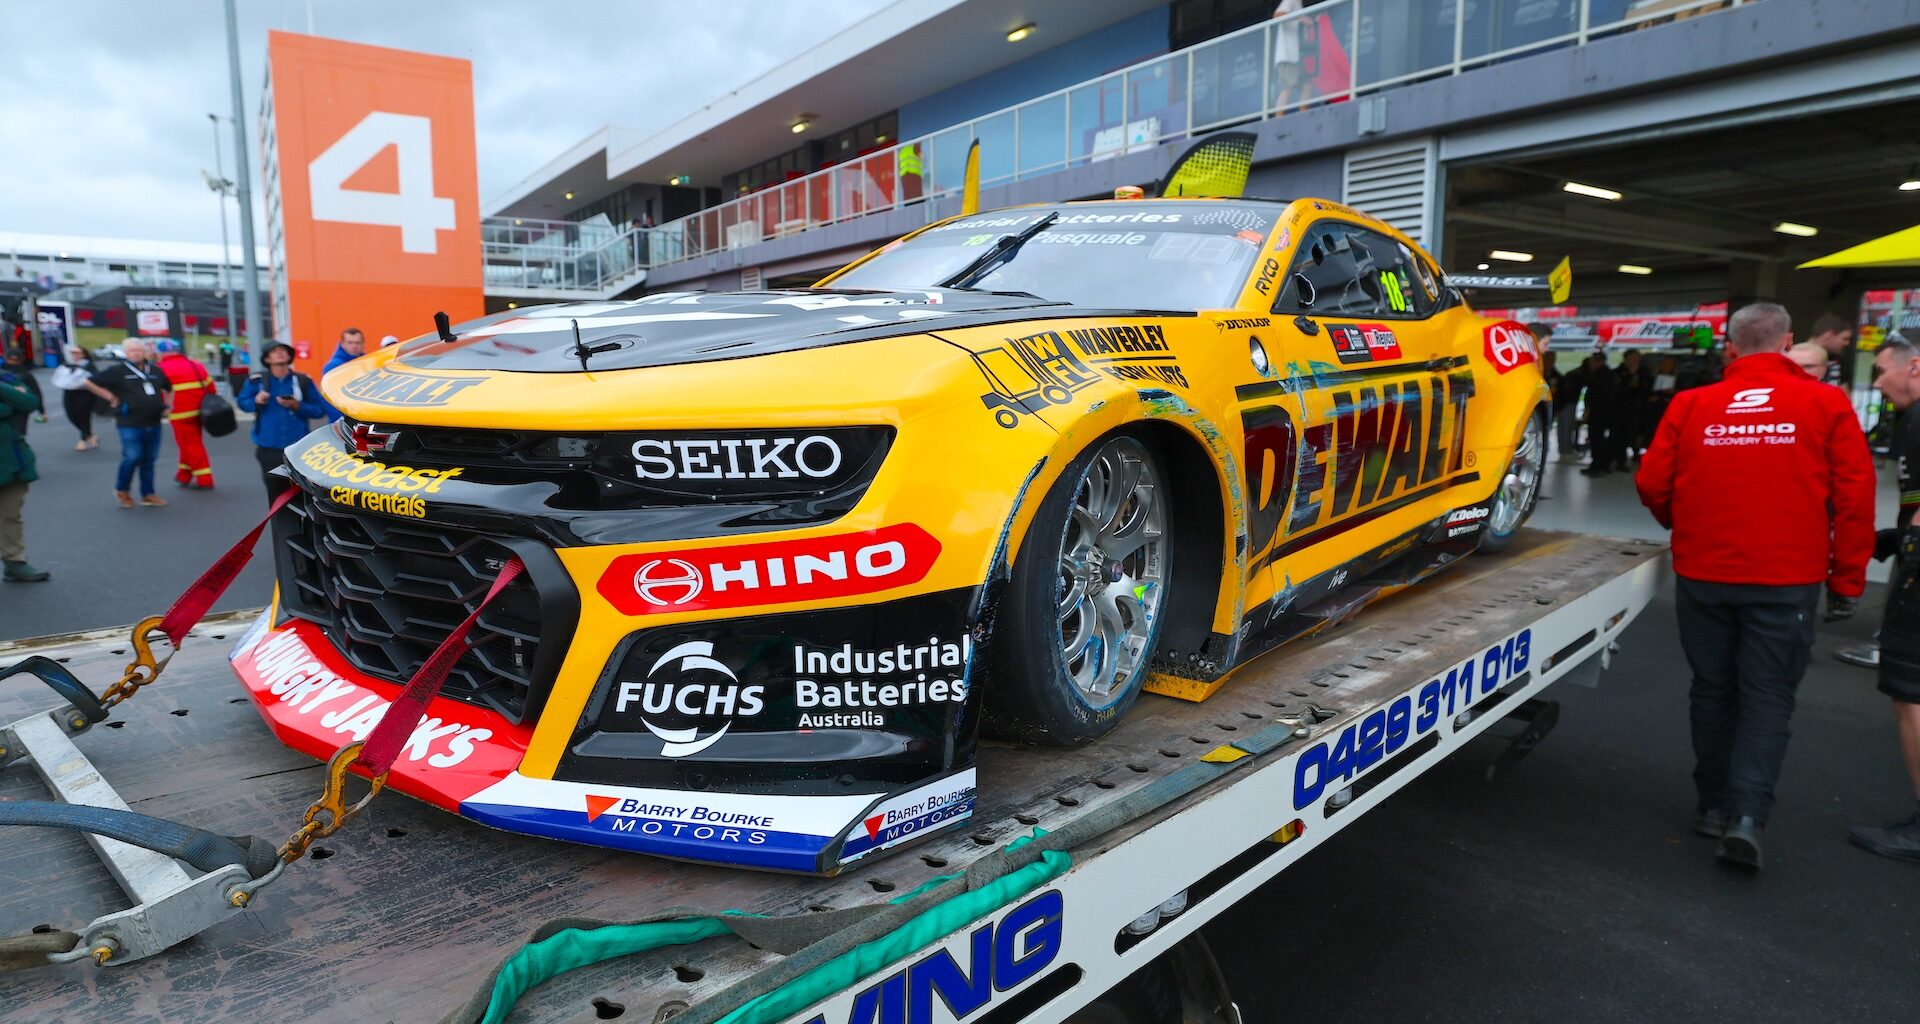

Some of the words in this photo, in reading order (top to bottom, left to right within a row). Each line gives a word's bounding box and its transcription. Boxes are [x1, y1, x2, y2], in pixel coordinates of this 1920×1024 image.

[308, 110, 456, 255] 4
[1033, 231, 1146, 247] Pasquale
[1255, 258, 1280, 296] RYCO
[1381, 271, 1405, 311] 18
[1067, 325, 1169, 356] WAVERLEY
[1224, 317, 1270, 329] DUNLOP
[345, 370, 489, 404] DEWALT
[1703, 437, 1761, 446] RECOVERY
[1764, 436, 1796, 444] TEAM
[1728, 423, 1796, 434] HINO
[300, 442, 465, 493] eastcoast
[631, 435, 842, 480] SEIKO
[1241, 370, 1476, 558] DEWALT
[330, 486, 362, 507] car
[361, 489, 426, 518] rentals
[710, 541, 906, 591] HINO
[794, 633, 970, 674] Industrial
[254, 628, 355, 714] HUNGRY
[321, 693, 493, 768] JAK'S
[615, 682, 765, 716] FUCHS
[796, 673, 968, 708] Batteries
[798, 711, 884, 727] Australia
[1293, 695, 1411, 811] 0429
[1417, 659, 1475, 735] 311
[1481, 628, 1531, 694] 013
[612, 818, 767, 844] MOTORS
